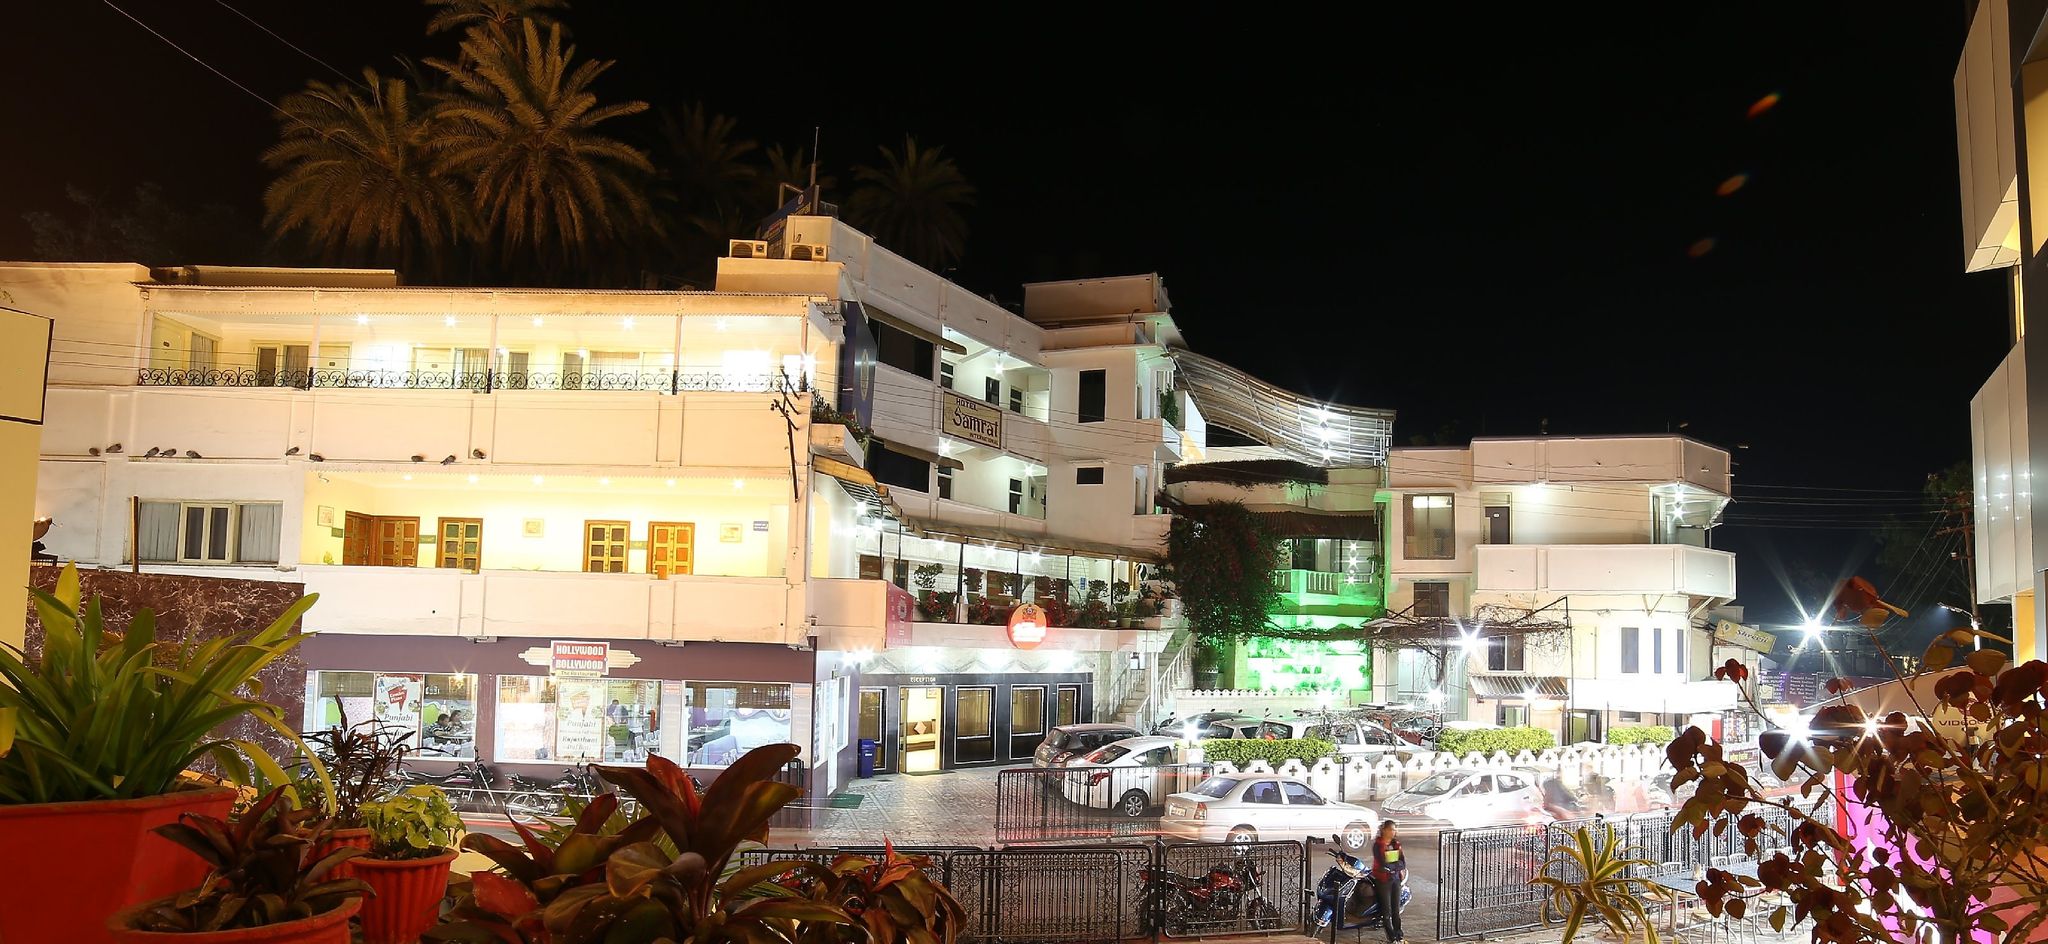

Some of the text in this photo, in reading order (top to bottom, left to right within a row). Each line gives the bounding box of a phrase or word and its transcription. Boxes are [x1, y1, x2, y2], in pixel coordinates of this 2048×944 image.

[956, 398, 977, 411] HOTEL
[953, 406, 998, 437] Samrat
[556, 645, 604, 656] HOLLYWOOD
[556, 660, 603, 670] BOLLYWOOD
[384, 714, 413, 722] Punjabi
